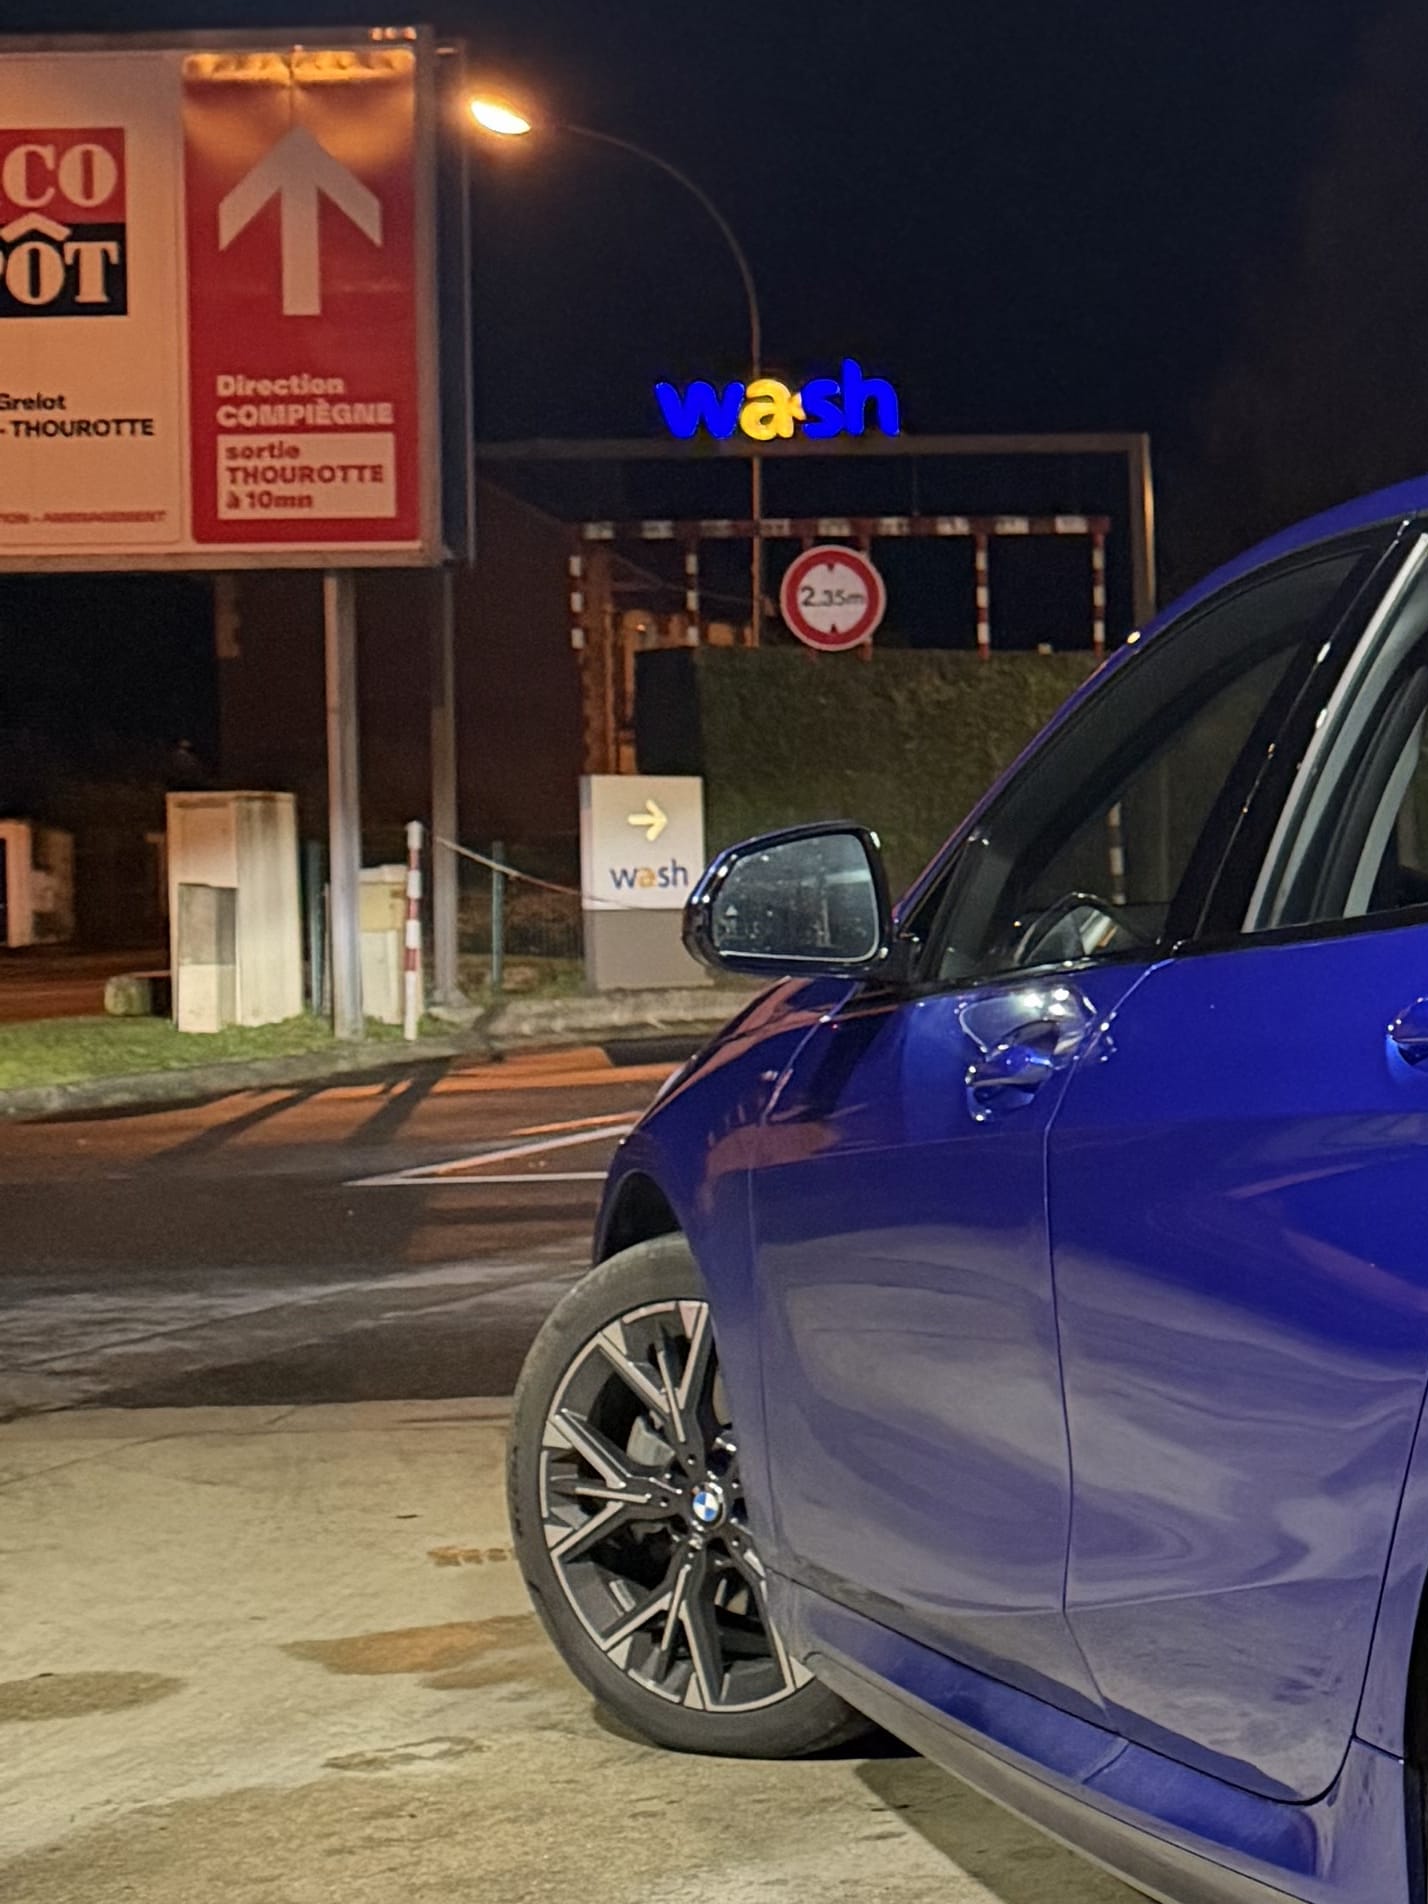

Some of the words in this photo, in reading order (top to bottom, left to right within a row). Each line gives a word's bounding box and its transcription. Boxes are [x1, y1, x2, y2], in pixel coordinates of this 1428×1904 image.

[0, 212, 119, 305] ÔT
[216, 374, 344, 395] Direction
[655, 358, 900, 441] wash
[216, 398, 394, 427] COMPIÈGNE
[10, 418, 155, 437] THOUROTTE
[225, 441, 300, 460] sortie
[226, 464, 383, 484] THOUROTTE
[226, 491, 240, 509] à
[244, 490, 314, 509] 10mn
[610, 857, 689, 890] wash
